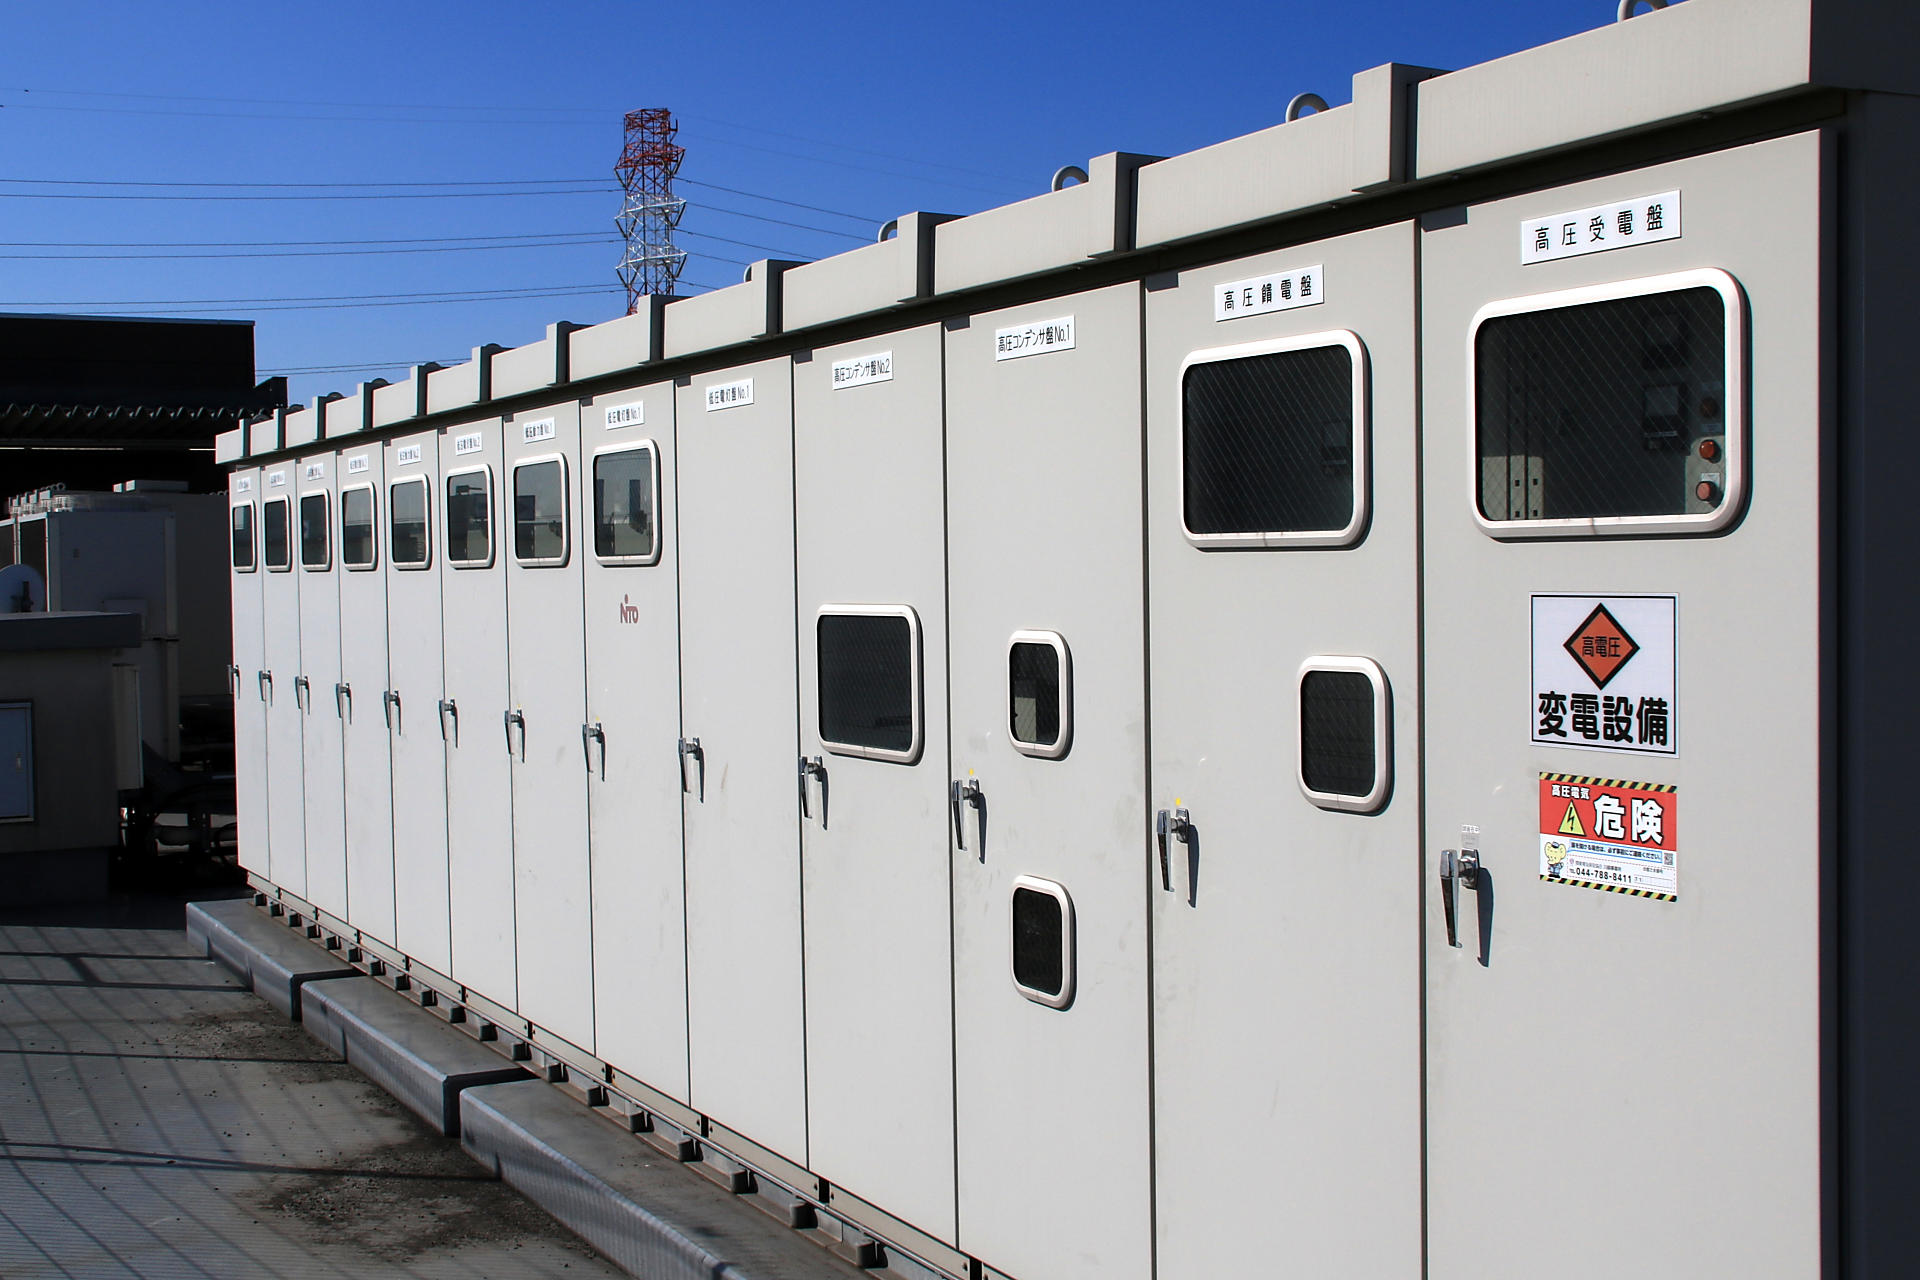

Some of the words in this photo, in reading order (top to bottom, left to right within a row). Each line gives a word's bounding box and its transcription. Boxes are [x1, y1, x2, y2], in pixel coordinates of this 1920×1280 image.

[1534, 203, 1664, 253] 高圧受電盤
[1581, 635, 1622, 658] 高電圧
[1538, 690, 1668, 747] 変電設備
[1551, 783, 1591, 801] 高圧電気
[1593, 793, 1664, 846] 危険
[1575, 867, 1632, 883] 044-788-8411
